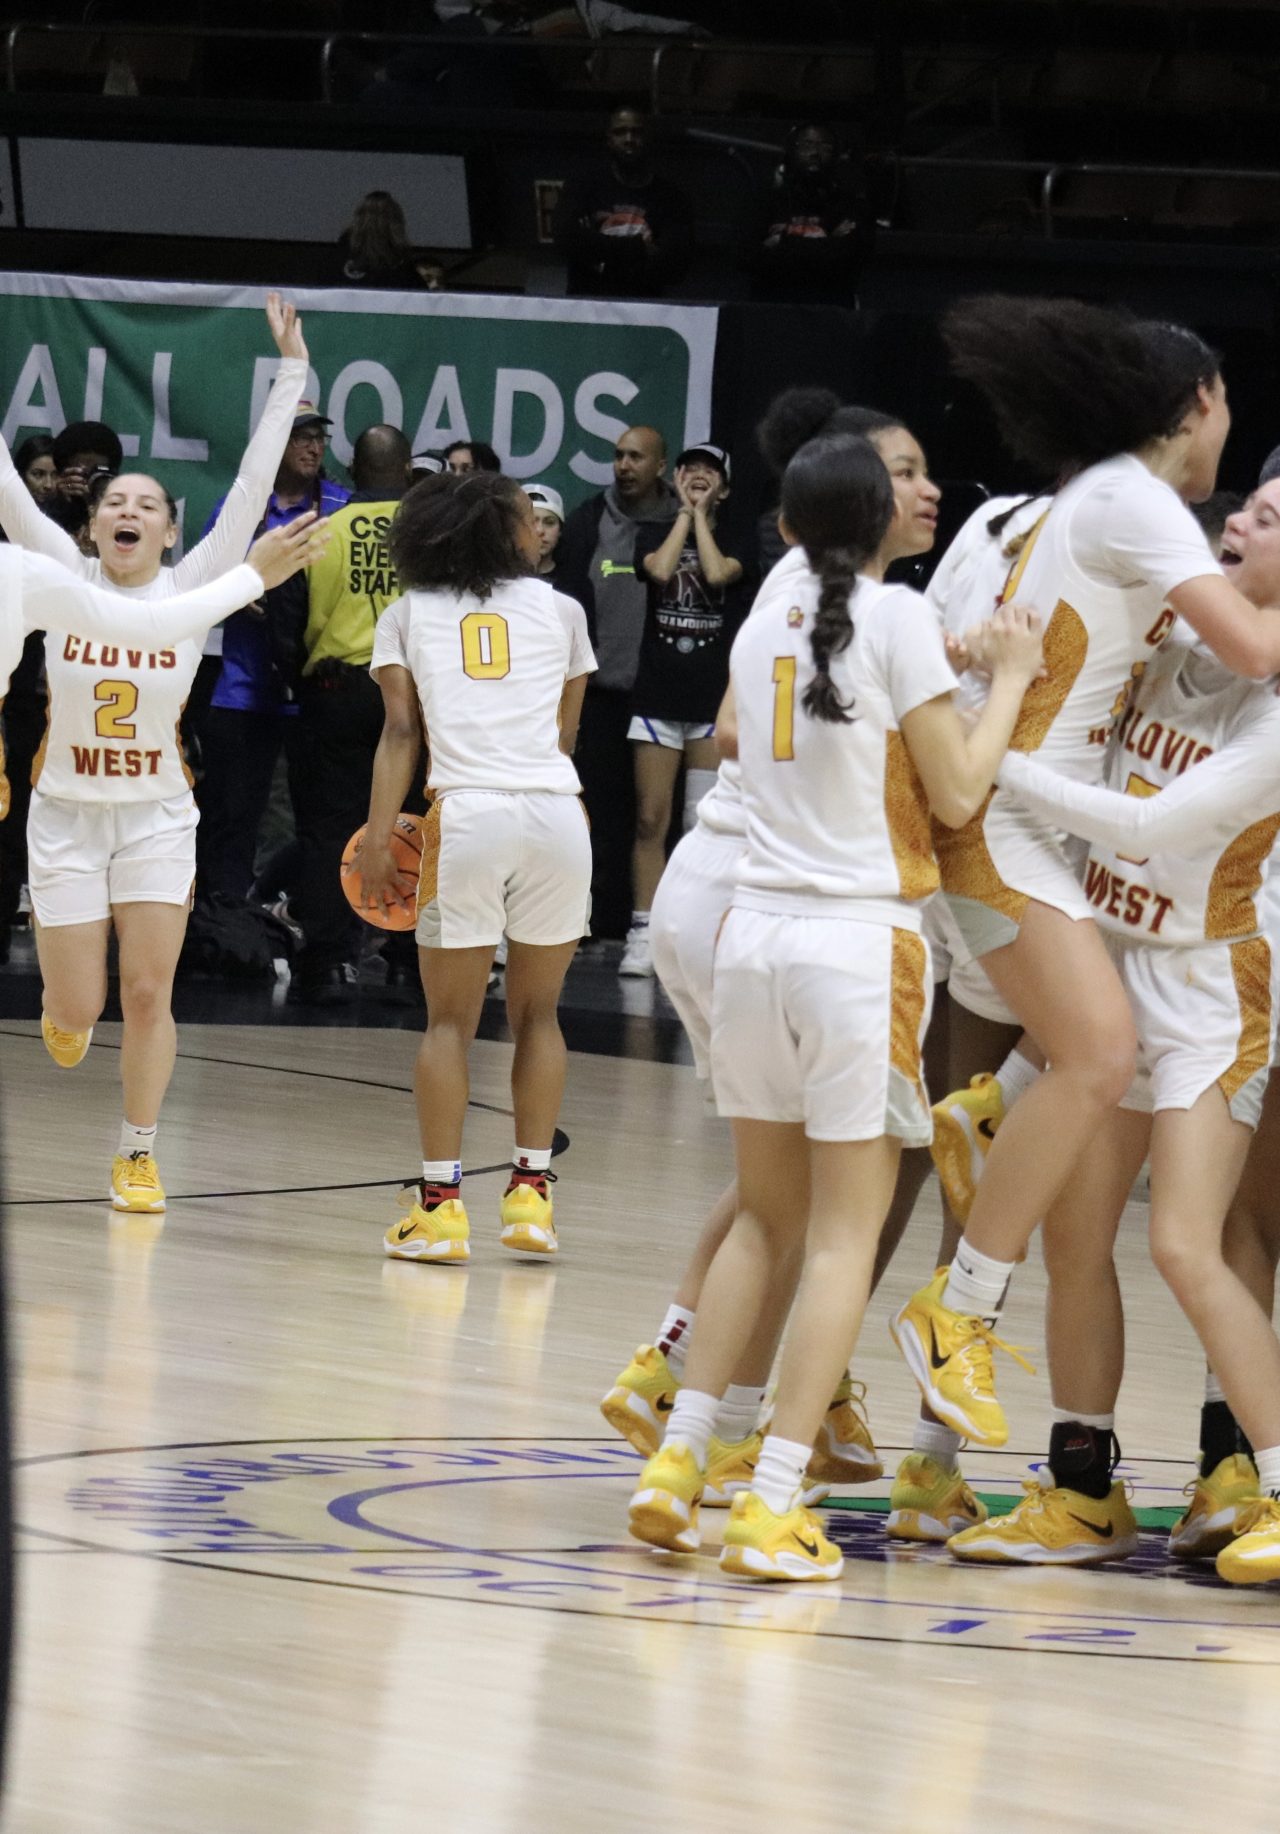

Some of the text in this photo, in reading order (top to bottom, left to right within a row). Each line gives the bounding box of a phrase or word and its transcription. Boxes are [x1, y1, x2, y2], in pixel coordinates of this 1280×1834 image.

[0, 343, 209, 463] ALL
[350, 541, 393, 568] EVE
[350, 569, 403, 596] STAF
[63, 633, 177, 669] CLOVIS
[460, 612, 511, 680] 0
[94, 679, 139, 739] 2
[772, 656, 797, 762] 1
[71, 745, 163, 778] WEST
[1085, 859, 1174, 934] WEST
